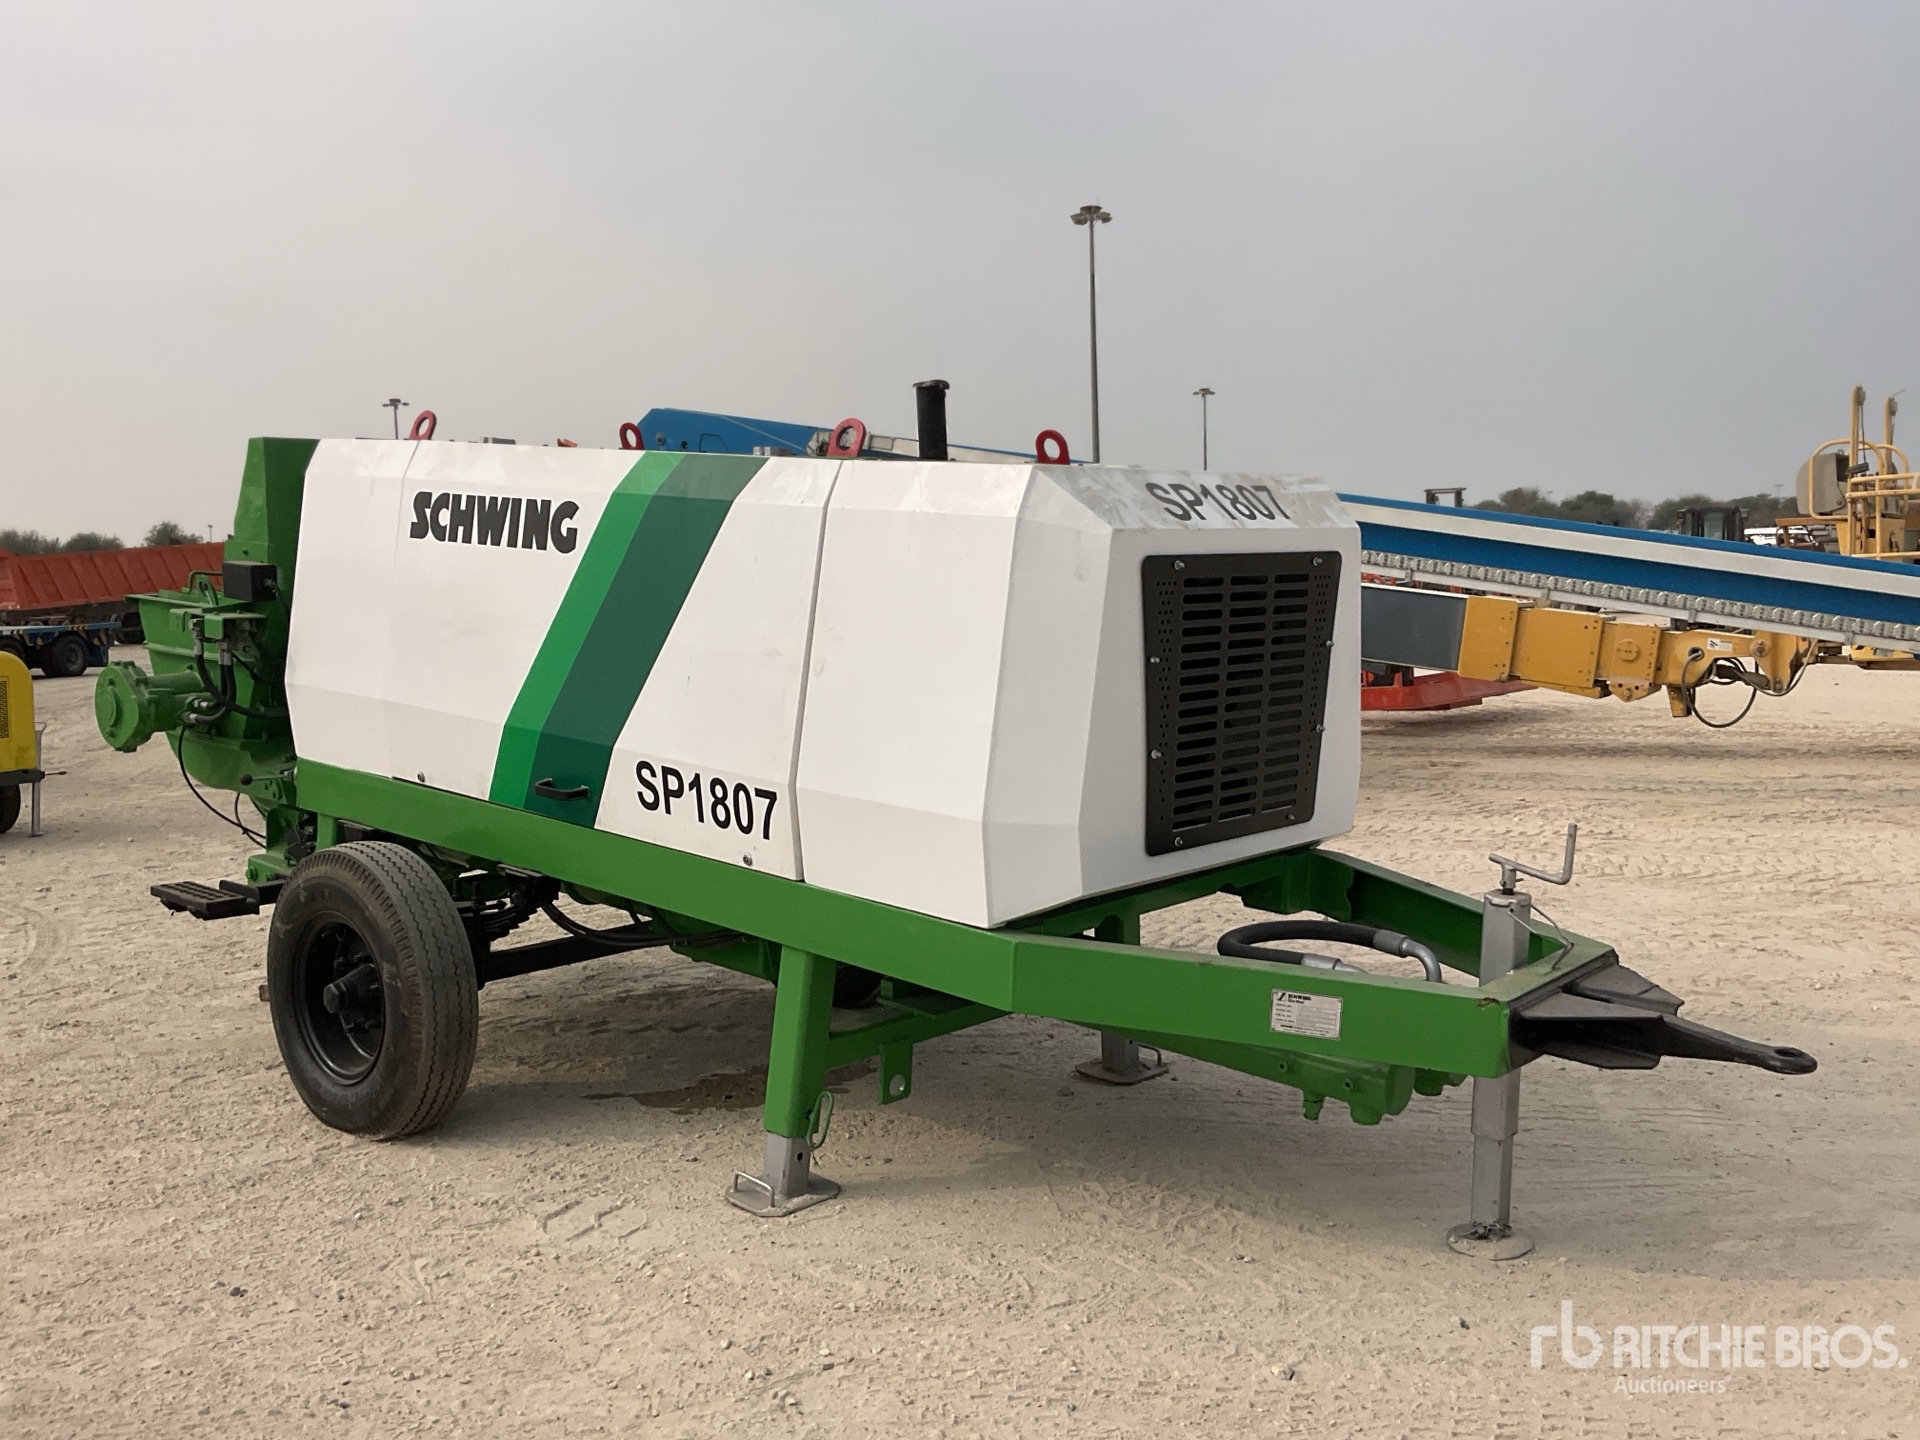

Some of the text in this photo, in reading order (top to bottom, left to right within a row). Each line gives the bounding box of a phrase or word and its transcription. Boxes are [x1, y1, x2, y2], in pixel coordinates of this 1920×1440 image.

[409, 490, 580, 554] SCHWING
[1145, 482, 1291, 521] SP1807
[635, 760, 778, 840] SP1807
